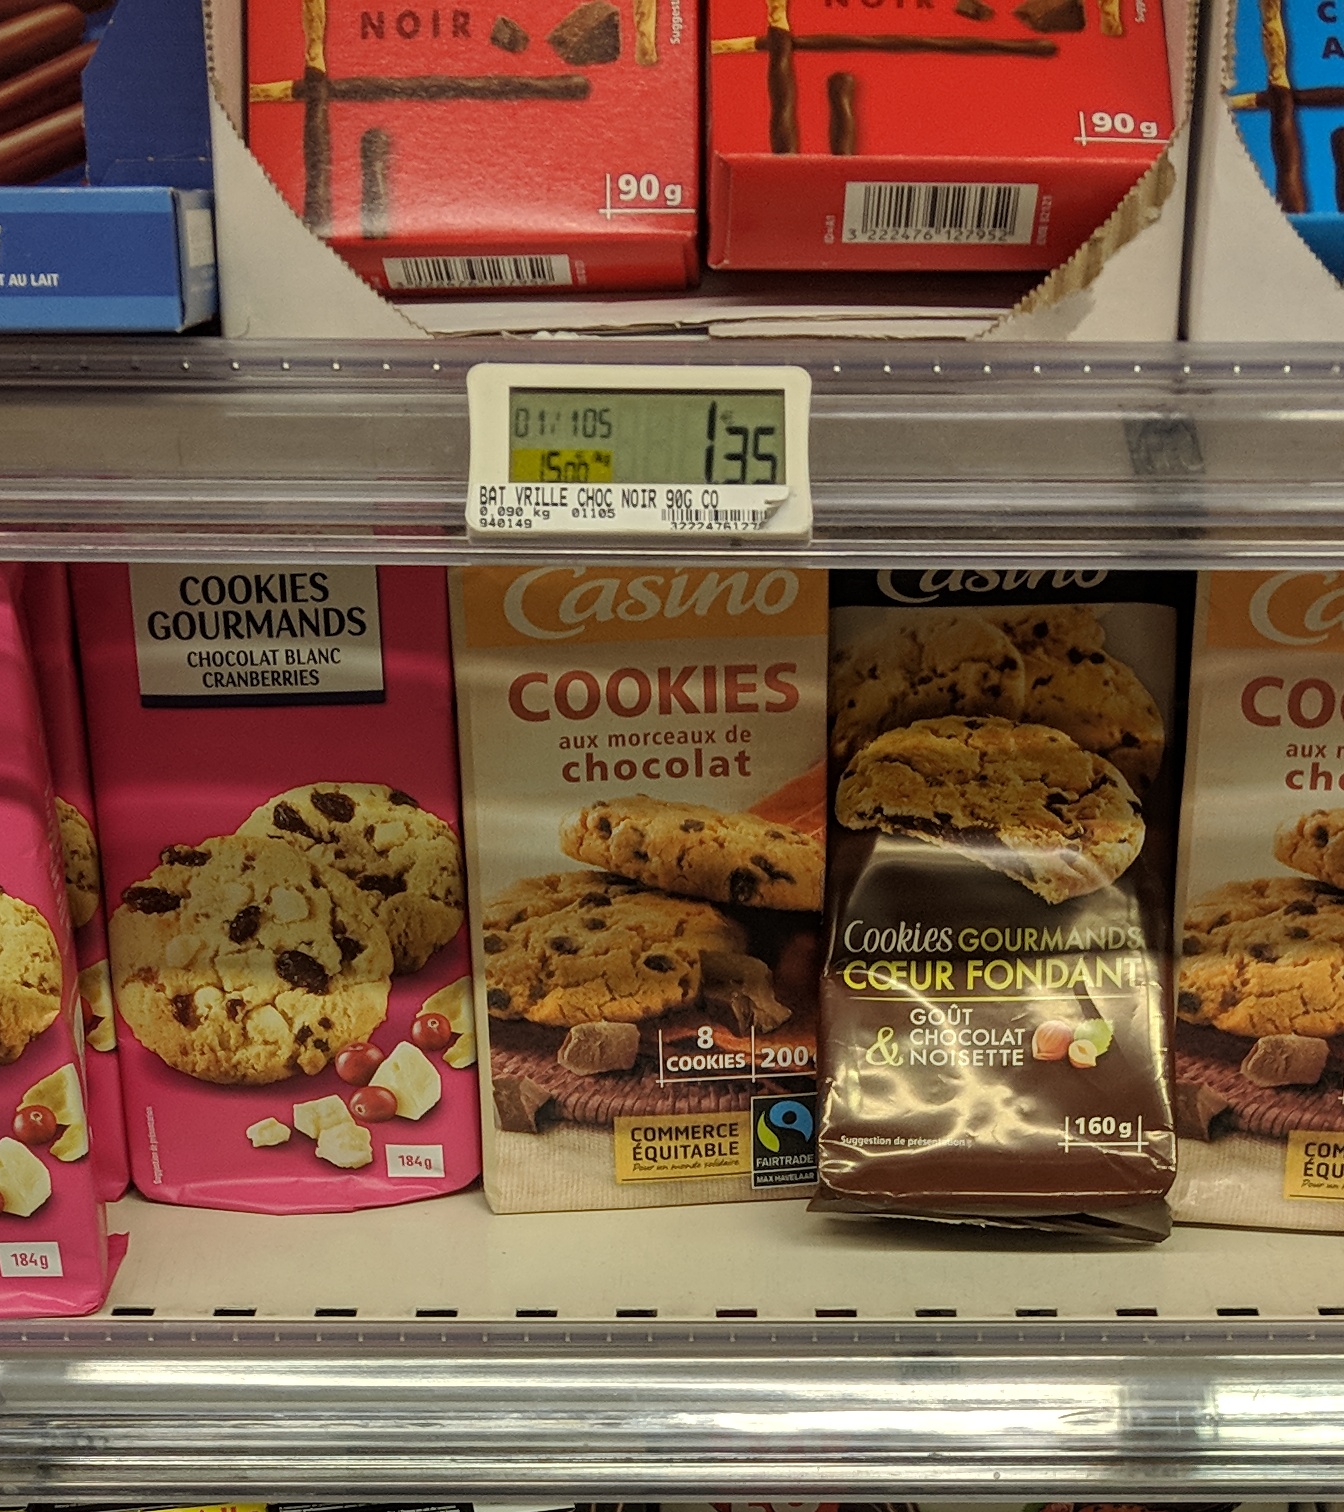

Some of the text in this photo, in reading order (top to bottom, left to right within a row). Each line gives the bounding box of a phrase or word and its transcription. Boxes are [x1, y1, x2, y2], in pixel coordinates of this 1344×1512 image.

[359, 7, 473, 39] NOIR
[7, 272, 26, 287] AU
[29, 272, 59, 287] LAIT
[479, 487, 719, 508] BAT VRILLE CHOC NOIR 90G CO
[480, 519, 532, 528] 940149
[533, 508, 550, 519] kg
[572, 508, 616, 519] 01105
[146, 606, 368, 641] GOURMANDS
[186, 648, 342, 668] CHOCOLAT BLANC
[201, 669, 320, 689] CRANBERRIES
[558, 725, 752, 750] aux morceaux de
[1285, 743, 1328, 761] aux
[562, 750, 752, 784] chocolat
[844, 919, 1144, 953] Cookies GOURMANDS
[843, 957, 1144, 991] CŒUR FONDANT
[909, 1005, 974, 1026] GOÛT
[696, 1026, 714, 1049] 8
[865, 1028, 1025, 1067] & NOISETTE
[909, 1027, 1026, 1047] CHOCOLAT
[667, 1051, 746, 1072] COOKIES
[631, 1123, 739, 1142] COMMERCE
[633, 1141, 739, 1162] ÉQUITABLE
[756, 1154, 815, 1168] FAIRTRADE
